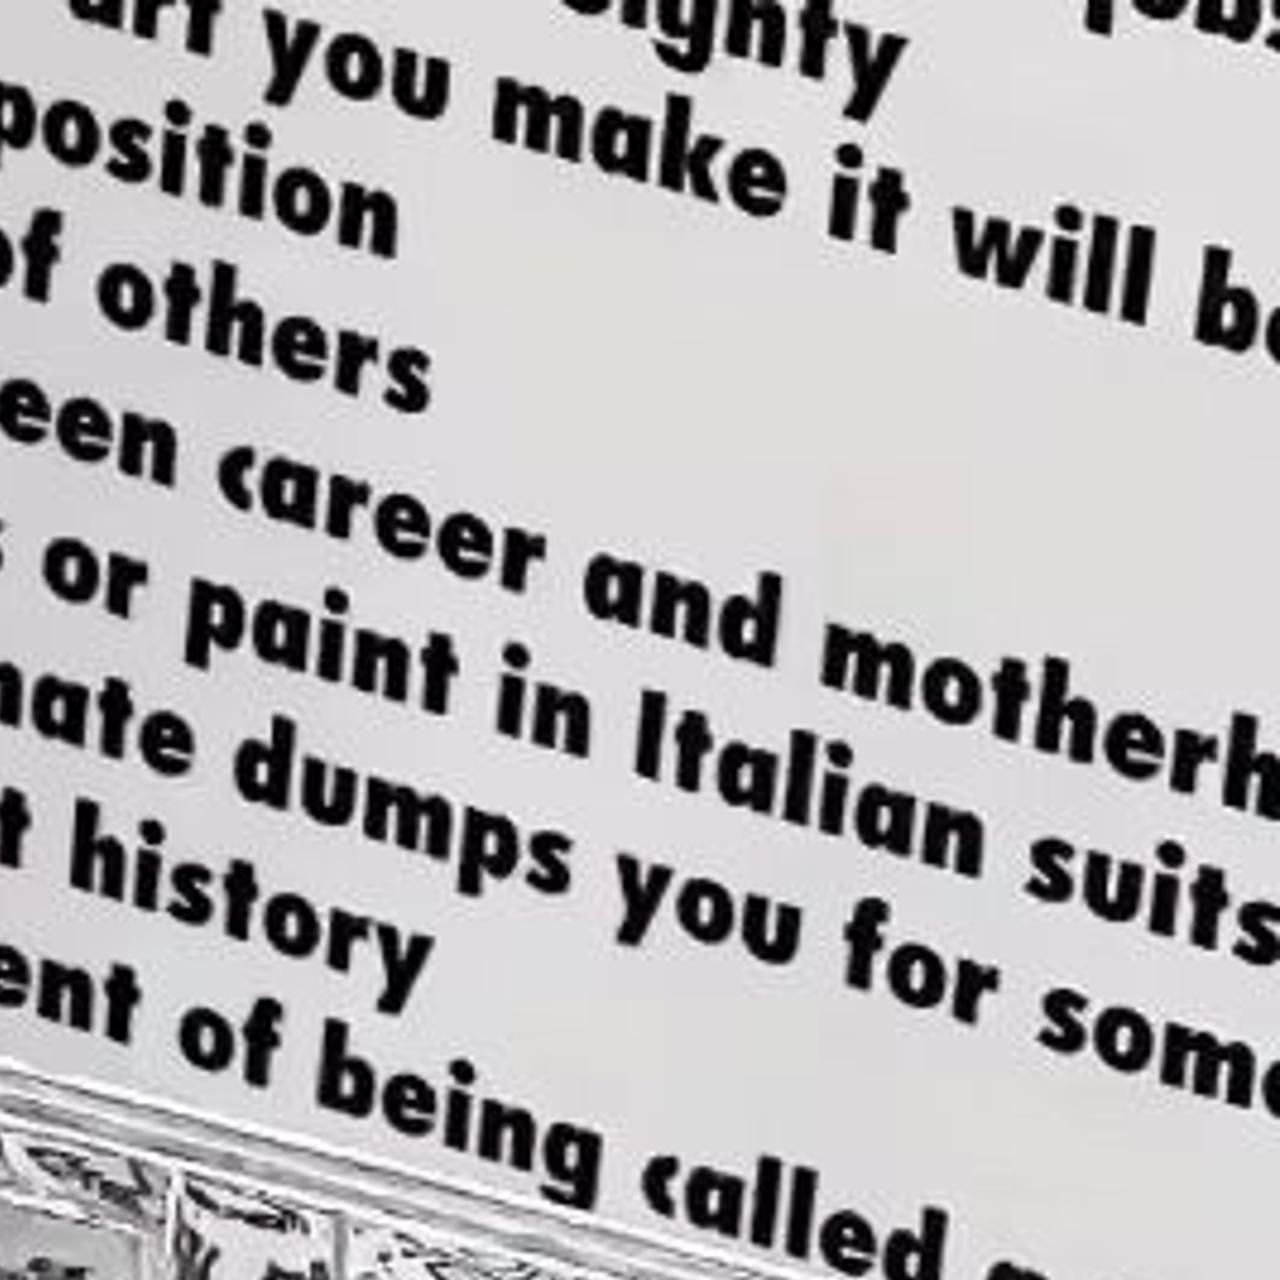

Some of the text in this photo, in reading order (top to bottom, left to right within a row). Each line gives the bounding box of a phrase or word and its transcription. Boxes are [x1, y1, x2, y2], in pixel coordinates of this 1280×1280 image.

[563, 0, 908, 123] ghty
[263, 9, 449, 120] you
[493, 78, 786, 217] make
[829, 144, 909, 254] it
[953, 206, 1155, 325] will
[1195, 246, 1280, 363] b
[98, 260, 430, 413] others
[218, 447, 546, 593] career
[584, 554, 782, 668] and
[43, 538, 148, 619] or
[185, 578, 459, 715] paint
[497, 643, 589, 758] in
[636, 690, 983, 878] Italian
[1025, 838, 1280, 965] suits
[70, 798, 434, 1015] history
[234, 715, 572, 897] dumps
[617, 854, 801, 964] you
[844, 898, 999, 1024] for
[179, 998, 283, 1088] of
[317, 1018, 602, 1210] being
